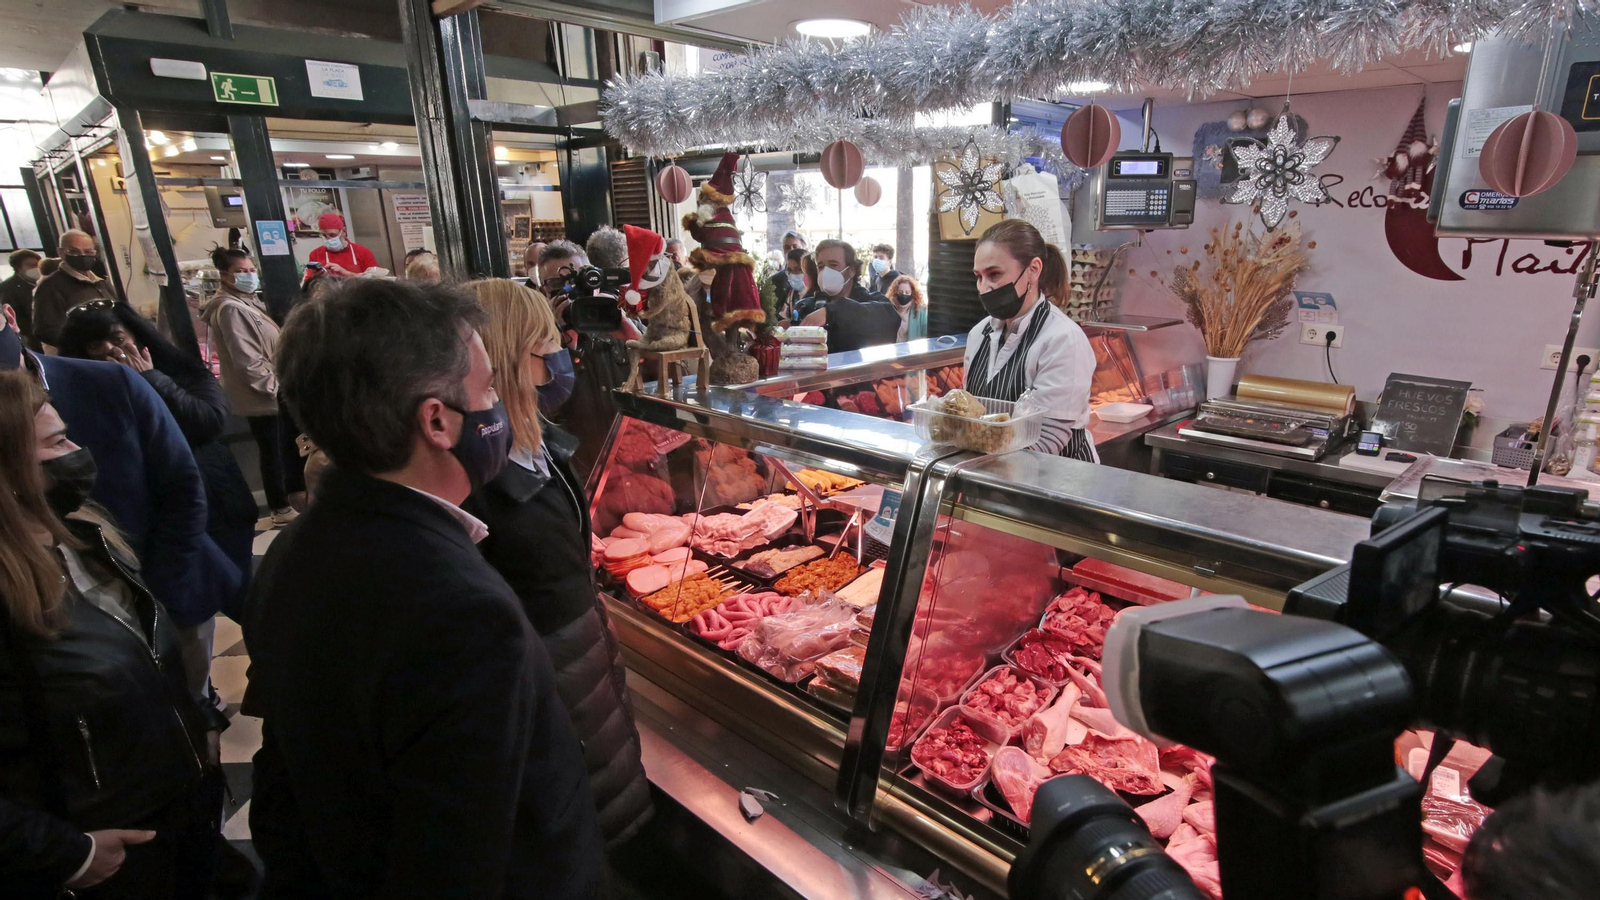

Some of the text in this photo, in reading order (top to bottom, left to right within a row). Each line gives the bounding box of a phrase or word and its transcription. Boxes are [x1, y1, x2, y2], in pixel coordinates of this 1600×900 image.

[1462, 238, 1600, 276] Mait
[1399, 389, 1453, 405] HUEVOS
[1387, 400, 1446, 416] FRESCOS
